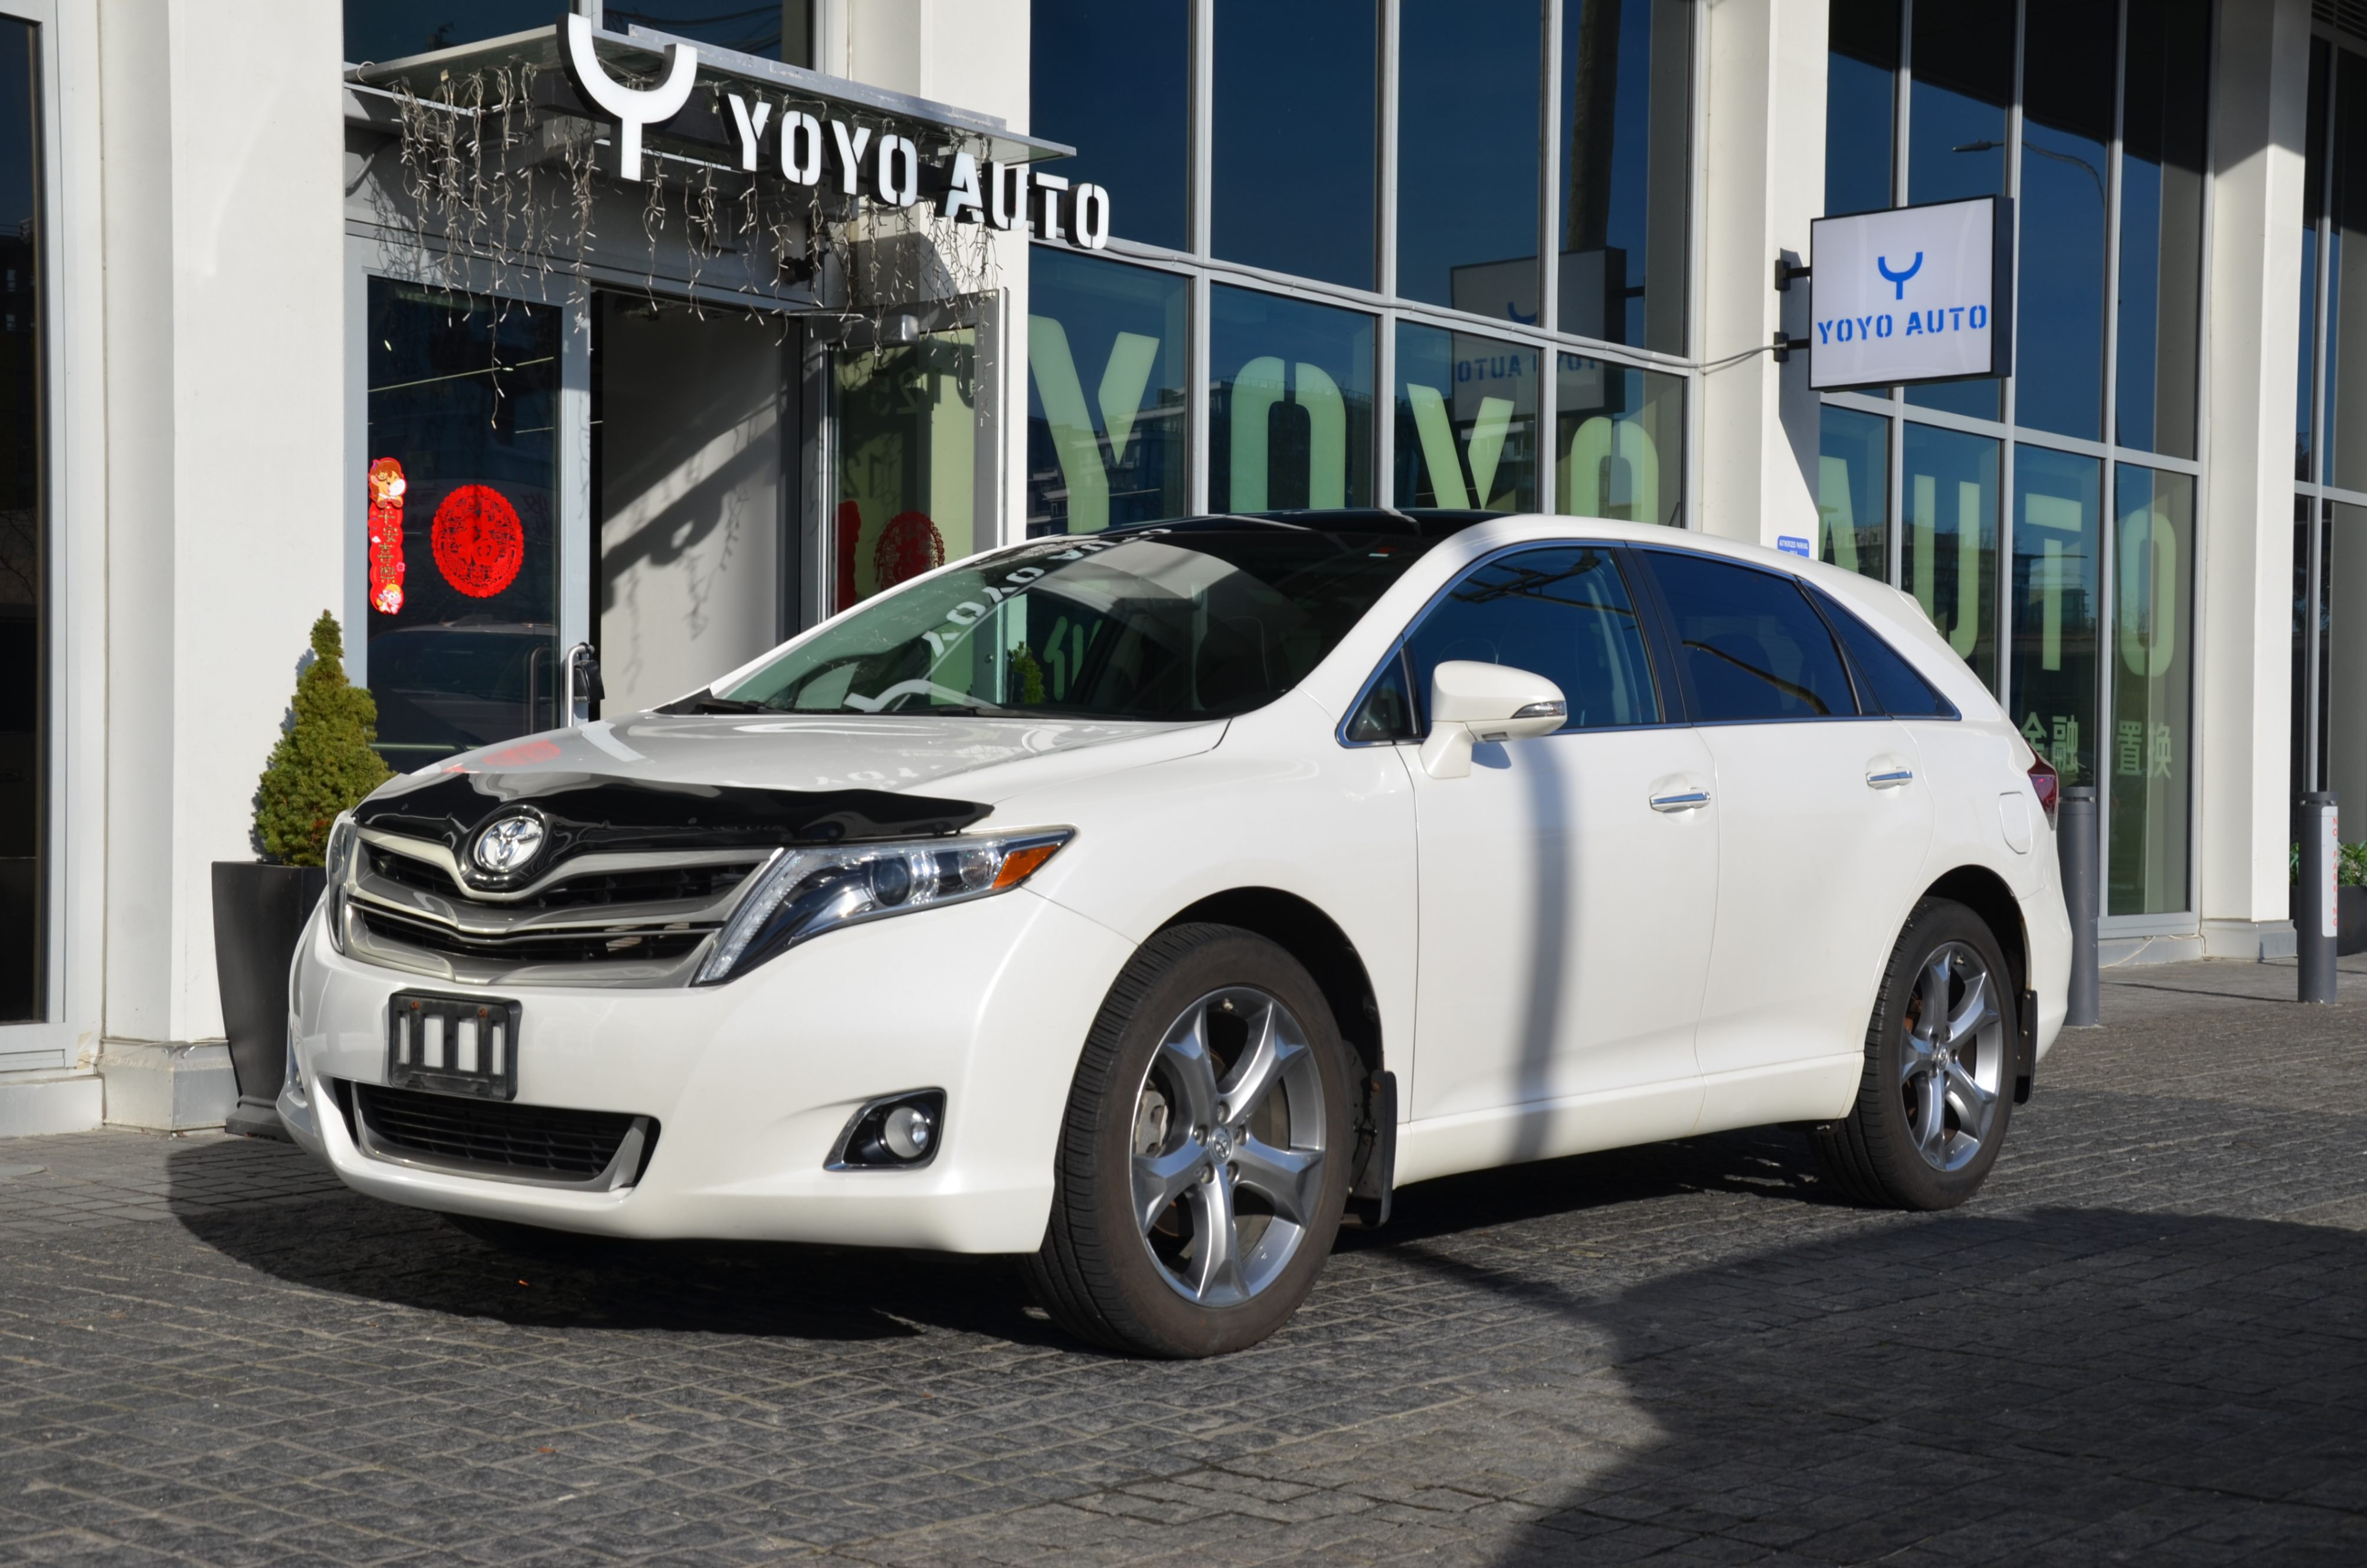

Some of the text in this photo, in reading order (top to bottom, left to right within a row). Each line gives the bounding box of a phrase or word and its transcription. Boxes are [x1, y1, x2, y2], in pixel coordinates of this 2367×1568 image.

[728, 94, 1110, 249] YOYO AUTO
[1818, 305, 1987, 344] YOYO AUTO
[2333, 817, 2338, 836] NO
